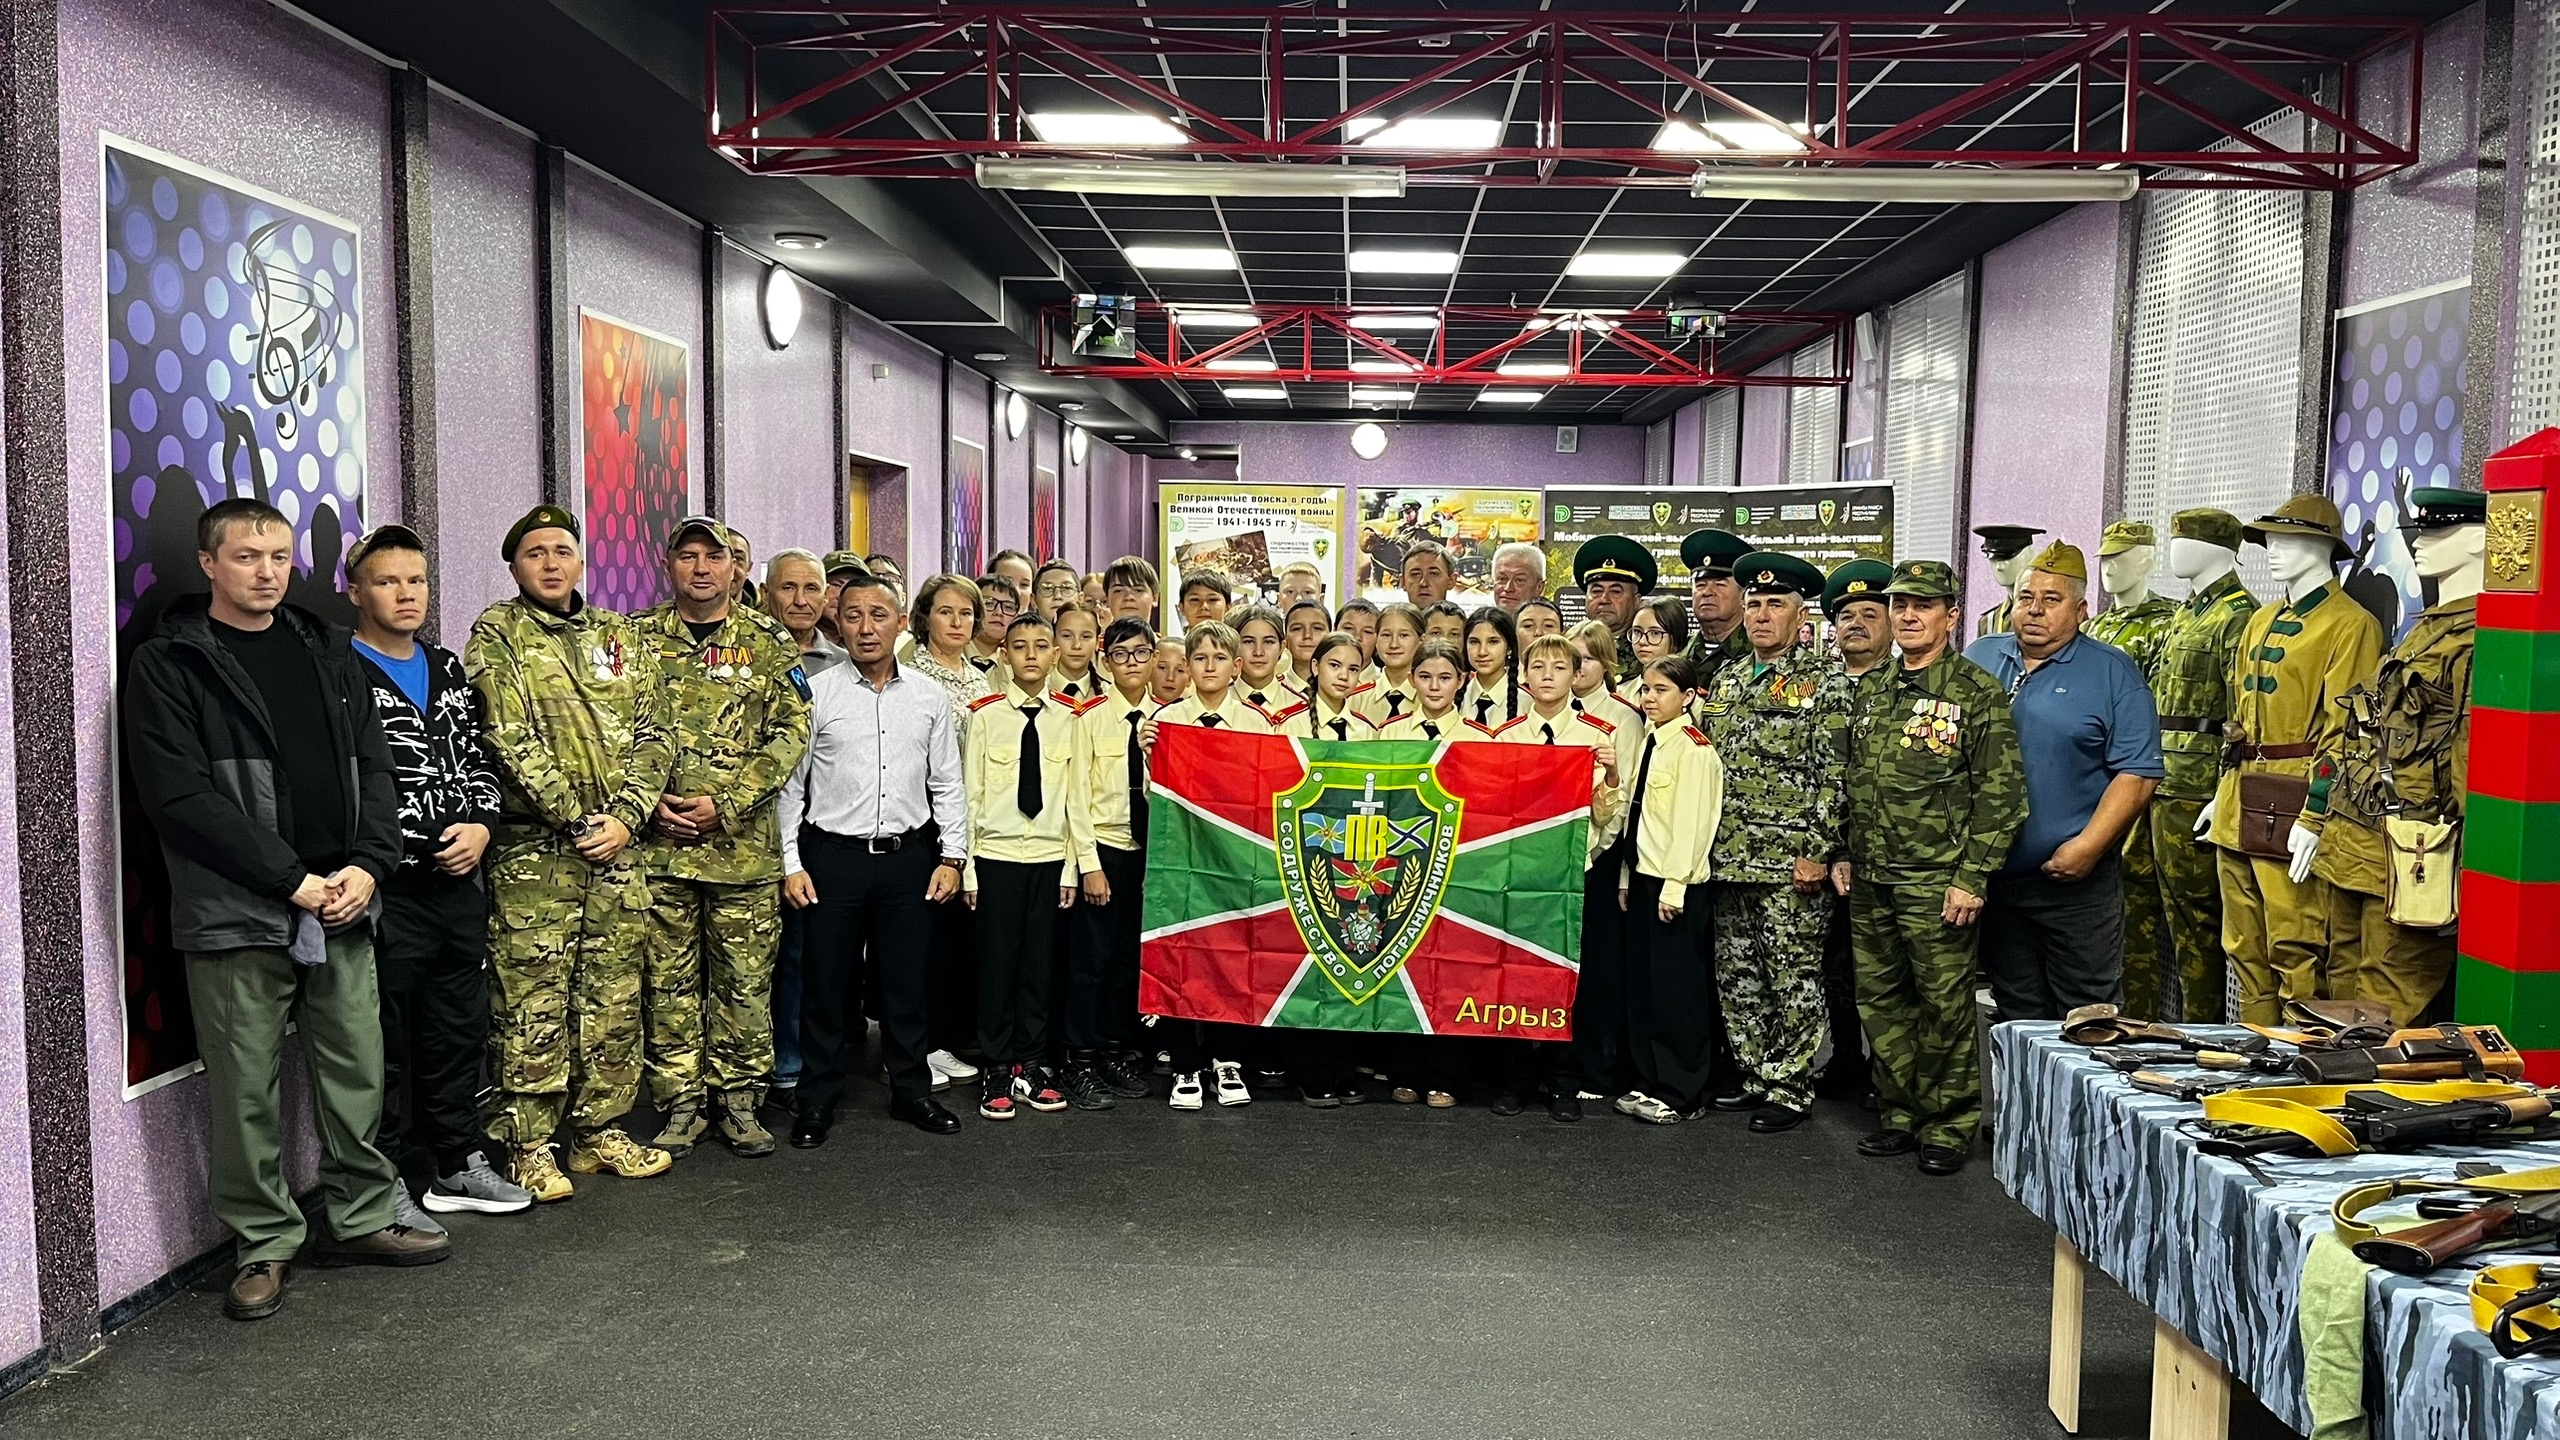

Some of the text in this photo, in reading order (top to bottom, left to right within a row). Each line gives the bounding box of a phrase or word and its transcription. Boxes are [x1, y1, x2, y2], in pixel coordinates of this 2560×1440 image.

[1170, 504, 1334, 516] Великой Отечественной войны
[1177, 493, 1247, 504] Пограничные
[1251, 494, 1287, 504] войска
[1300, 496, 1327, 505] годы
[1217, 517, 1272, 527] 1941-1945
[1344, 815, 1389, 861] ПВ
[1280, 821, 1347, 977] СОДРУЖЕСТВО
[1372, 825, 1454, 980] ПОГРАНИЧНИКОВ
[1455, 996, 1567, 1031] Агрыз
